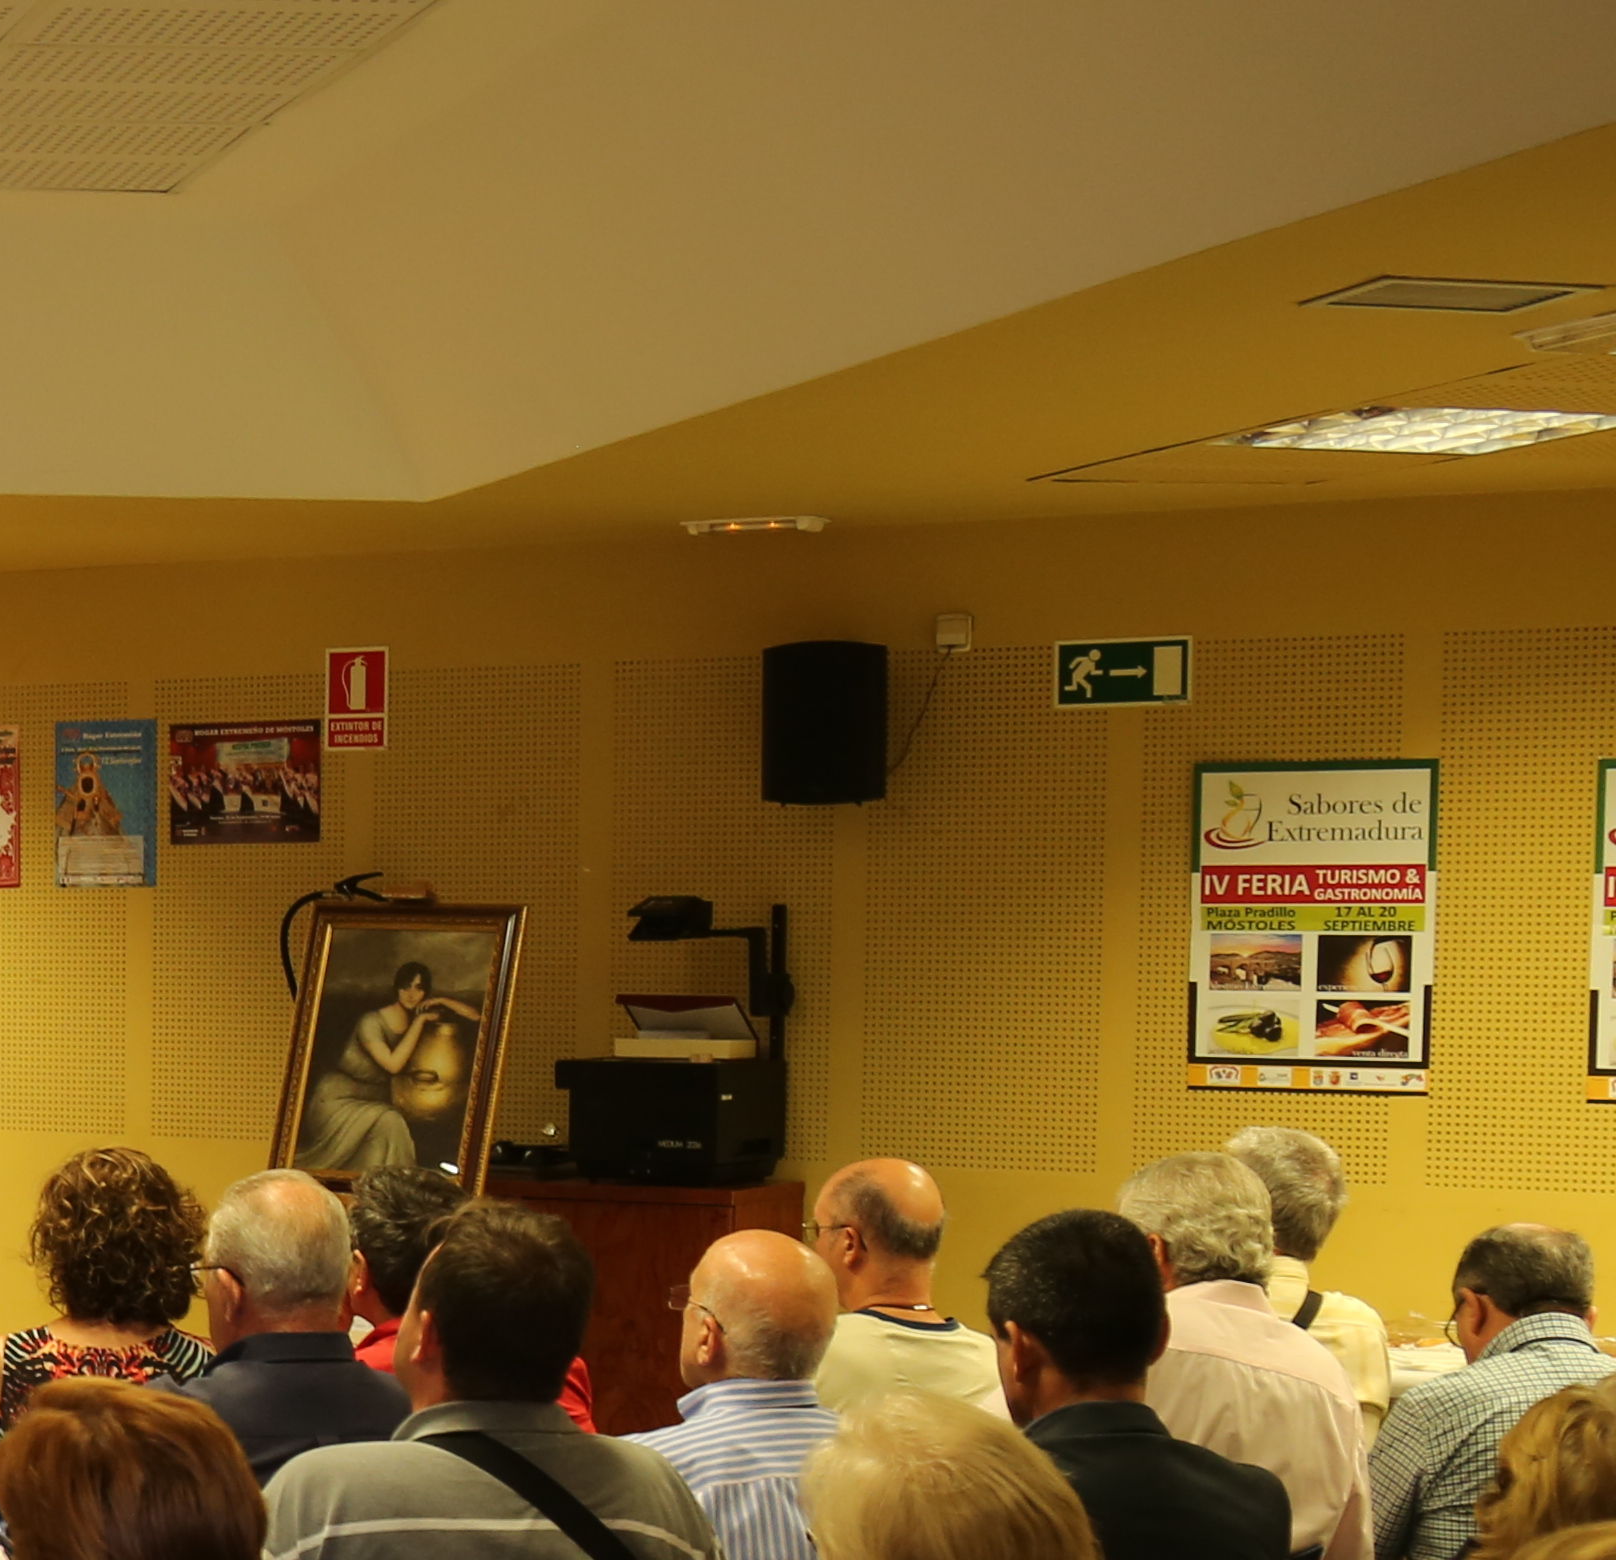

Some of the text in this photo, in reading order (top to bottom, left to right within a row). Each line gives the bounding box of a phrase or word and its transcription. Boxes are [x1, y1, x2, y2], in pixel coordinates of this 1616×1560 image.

[330, 721, 382, 731] EXTINTOR DE
[334, 734, 378, 744] INCENDIOS
[1287, 791, 1422, 816] Sabores de
[1267, 819, 1424, 842] Extremadura
[1316, 867, 1421, 885] TURISMO &
[1204, 874, 1311, 896] IV FERIA
[1314, 885, 1423, 900] GASTRONOMÍA
[1207, 907, 1296, 918] Plaza Pradillo
[1336, 907, 1397, 917] 17 AL 20
[1207, 919, 1296, 931] MÓSTOLES
[1324, 920, 1416, 931] SEPTIEMBRE
